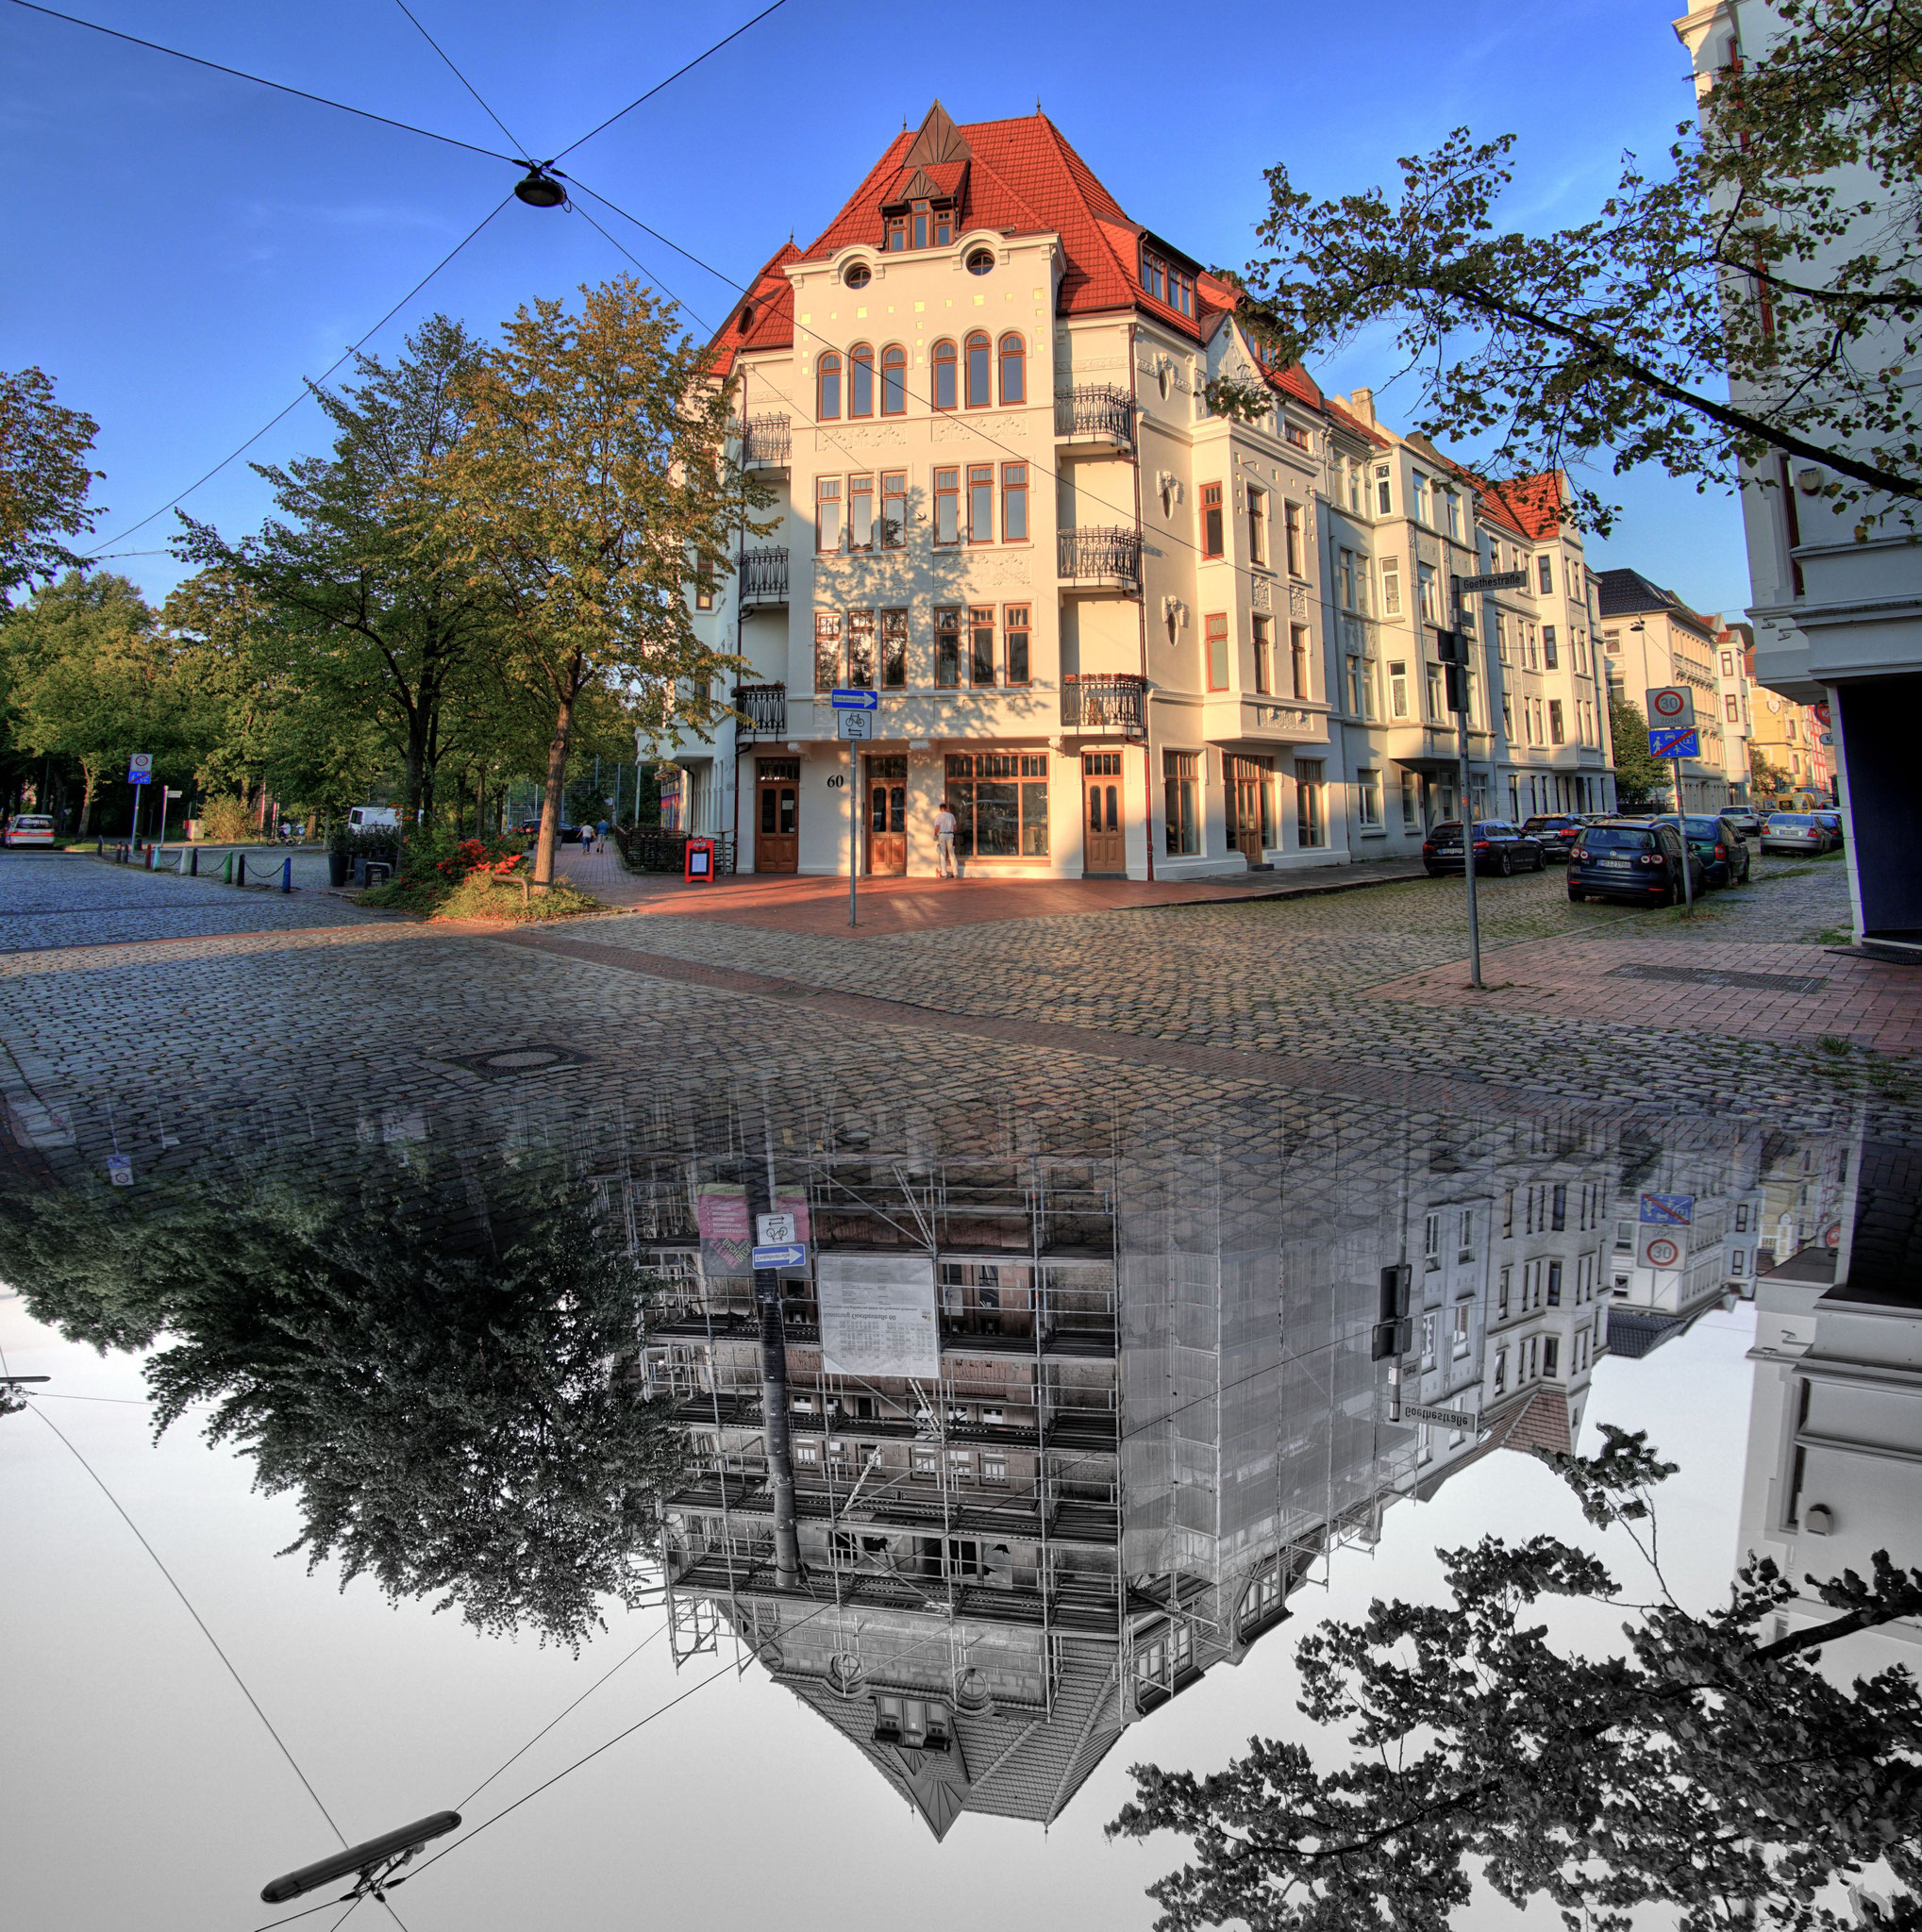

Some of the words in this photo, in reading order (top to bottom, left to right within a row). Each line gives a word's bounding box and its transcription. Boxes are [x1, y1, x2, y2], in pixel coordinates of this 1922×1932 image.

[1463, 574, 1521, 591] Goethestraße
[1660, 696, 1678, 710] 30
[1660, 716, 1683, 725] ZONE
[827, 774, 844, 789] 60
